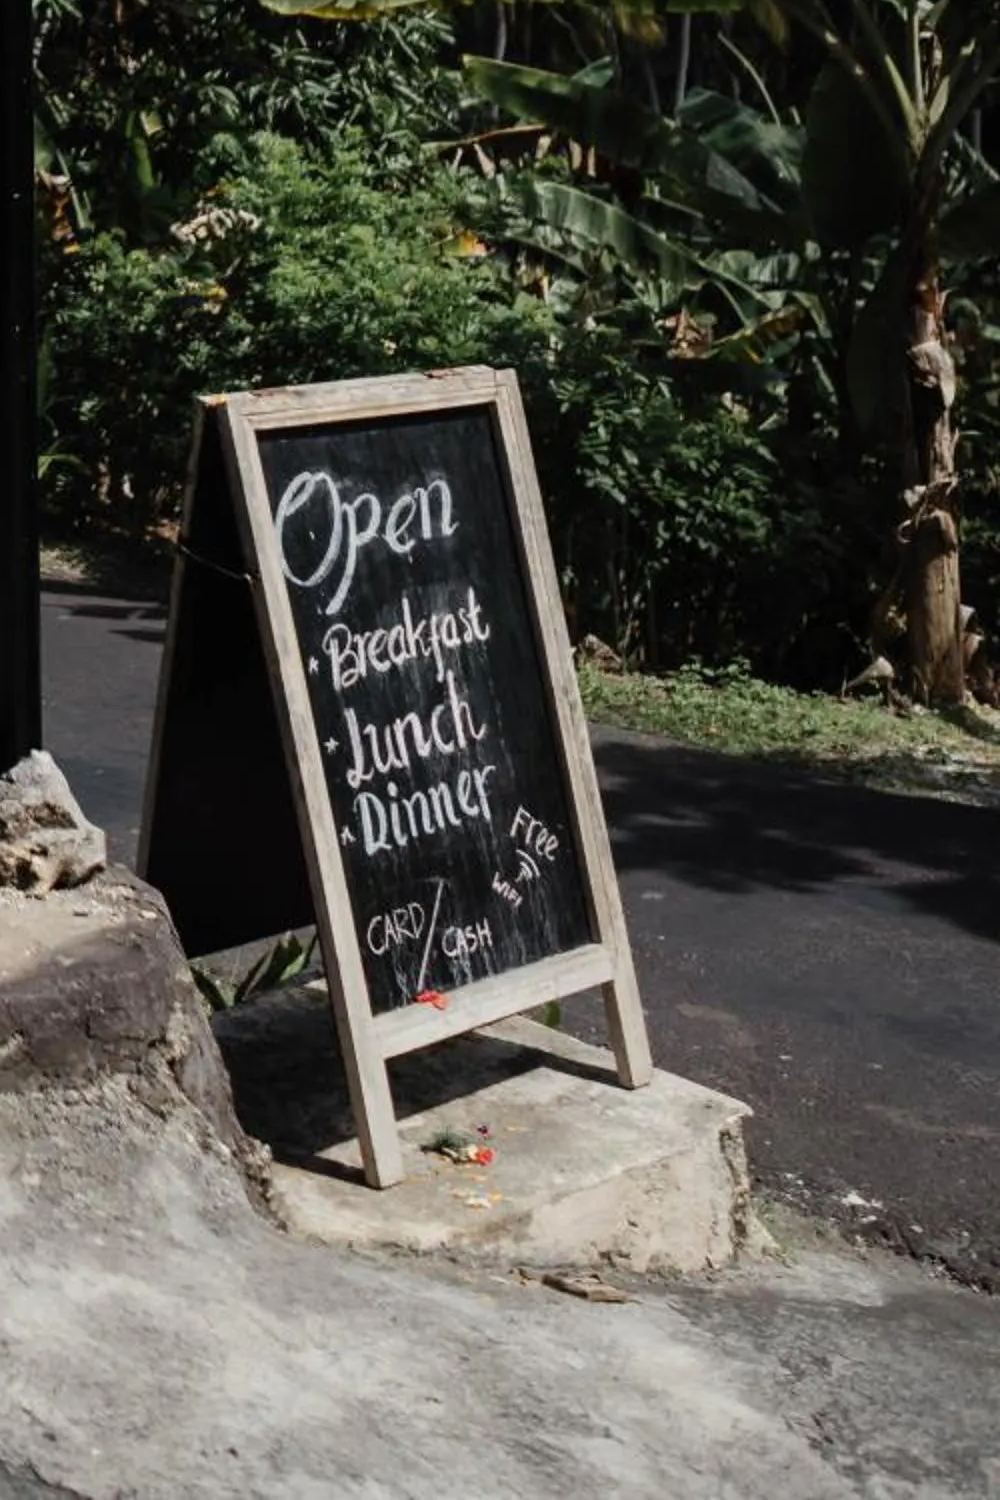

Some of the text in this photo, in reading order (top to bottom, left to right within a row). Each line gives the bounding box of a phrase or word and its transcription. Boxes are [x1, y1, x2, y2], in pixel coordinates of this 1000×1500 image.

[275, 470, 459, 614] Open
[323, 586, 491, 691] Breakfast
[344, 670, 486, 788] Lunch
[355, 764, 495, 856] Dinner
[510, 804, 560, 861] Free
[367, 902, 425, 955] CARD
[441, 917, 493, 957] CASH
